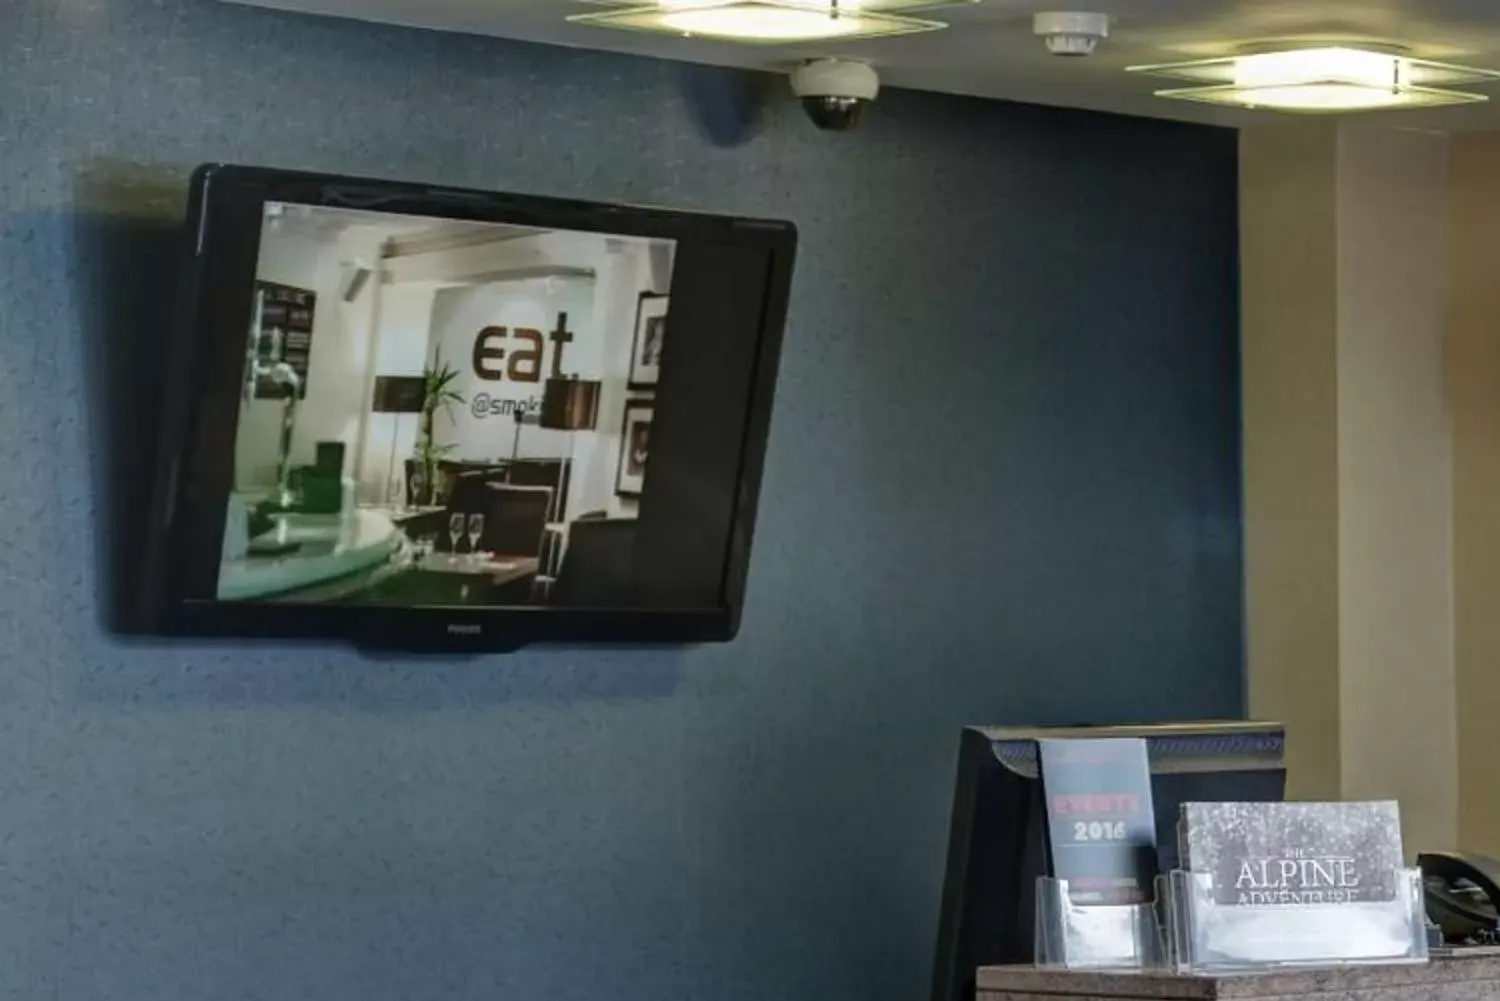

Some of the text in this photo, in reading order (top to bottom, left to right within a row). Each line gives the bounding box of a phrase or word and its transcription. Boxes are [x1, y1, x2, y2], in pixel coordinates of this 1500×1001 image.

[471, 311, 574, 382] eat
[1073, 820, 1127, 841] 2016
[1234, 859, 1361, 889] ALPINE
[1237, 889, 1360, 905] ADVENTURE
